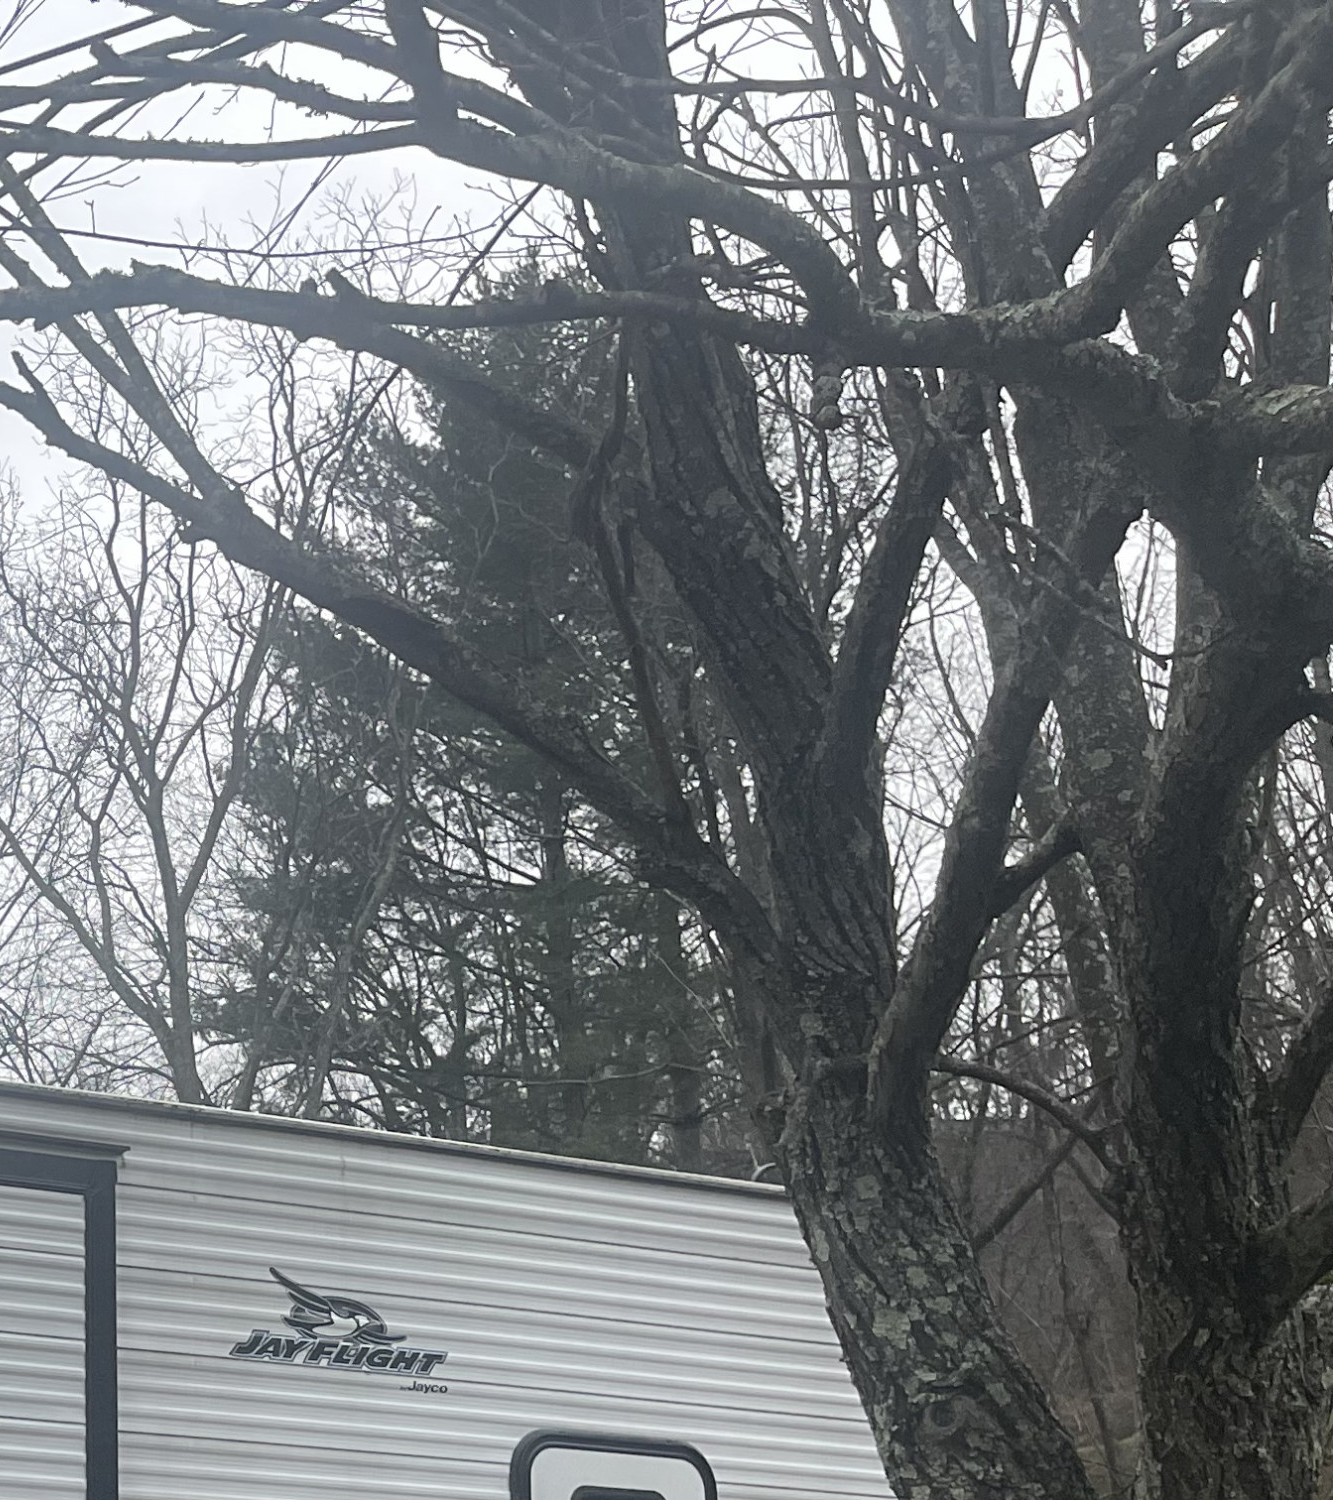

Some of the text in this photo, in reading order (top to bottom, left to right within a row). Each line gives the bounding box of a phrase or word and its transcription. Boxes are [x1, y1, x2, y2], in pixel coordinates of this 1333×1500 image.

[231, 1330, 447, 1375] JAY FLIGHT
[408, 1380, 448, 1394] Jayco
